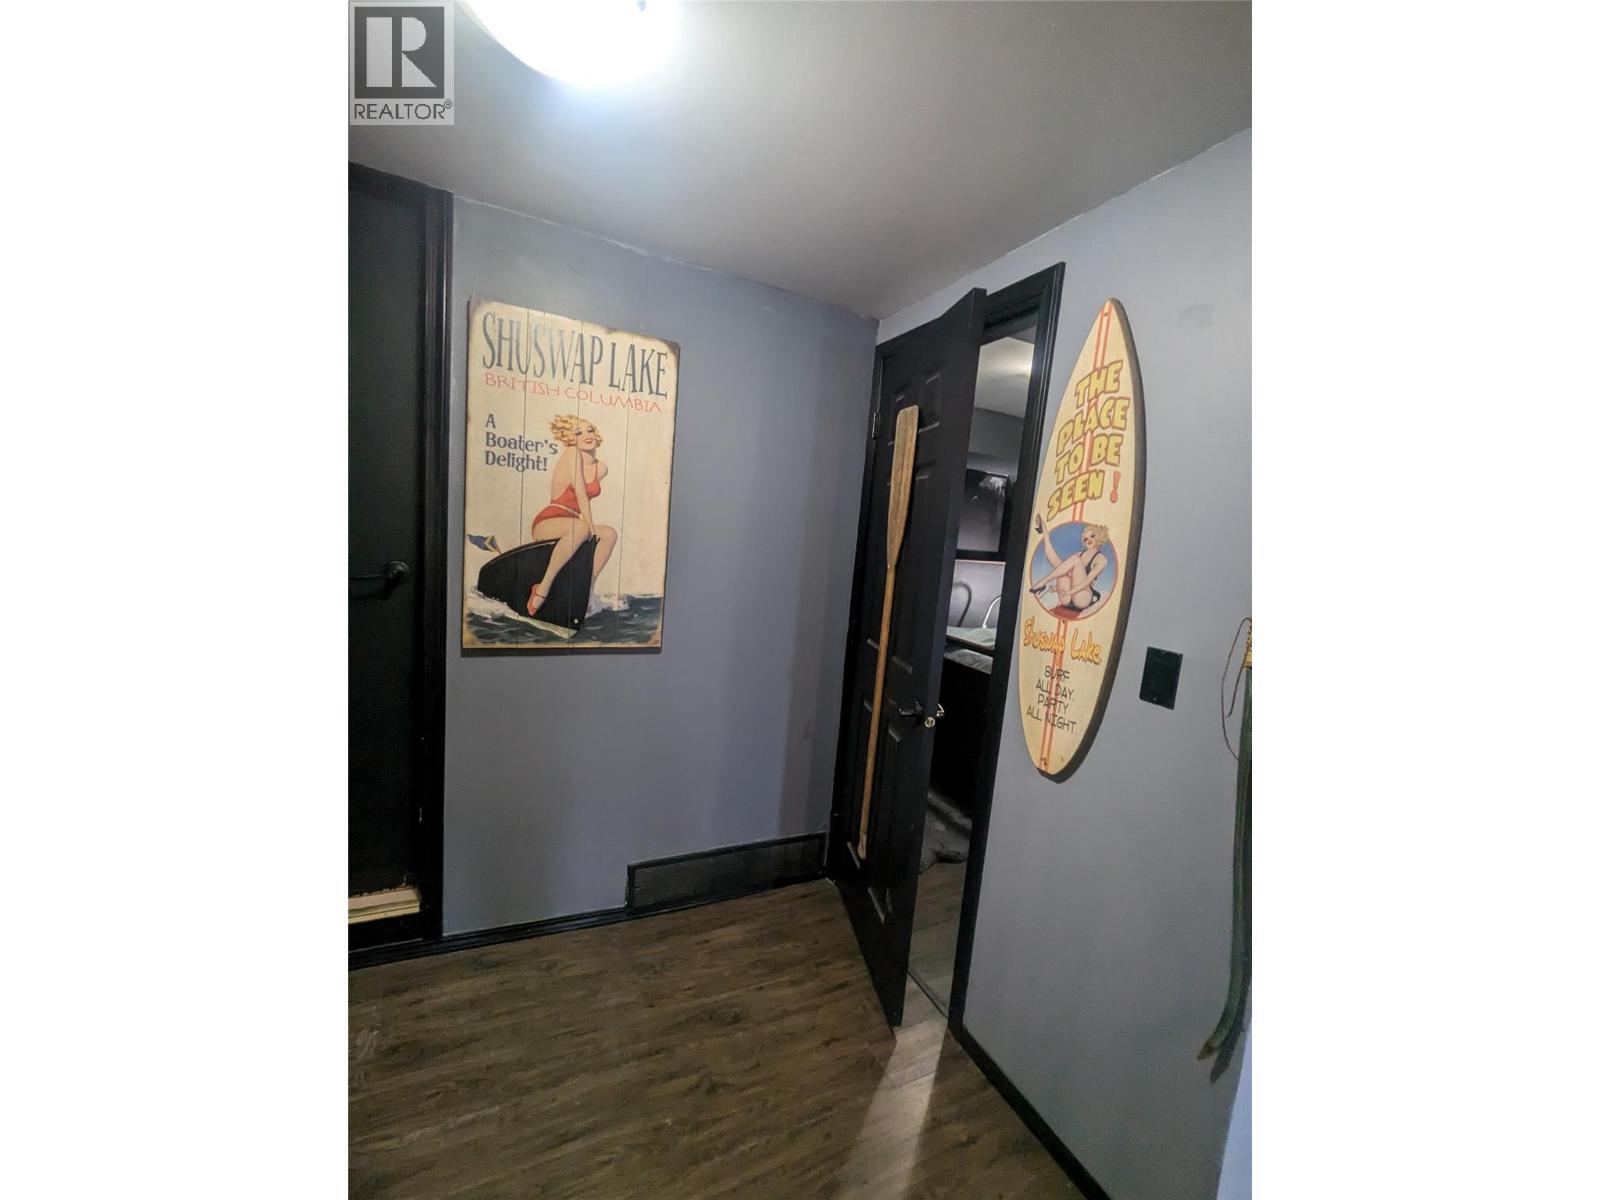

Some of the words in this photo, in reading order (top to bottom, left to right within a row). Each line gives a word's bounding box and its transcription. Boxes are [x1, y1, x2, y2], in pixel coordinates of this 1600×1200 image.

[482, 311, 604, 386] SHUSWAP
[608, 342, 668, 399] LAKE
[485, 372, 560, 396] BRITISH
[564, 387, 662, 413] COLUMBIA
[1074, 360, 1123, 409] THE
[485, 413, 496, 429] A
[1055, 397, 1130, 457] PLACE
[485, 431, 559, 455] Boater's
[484, 450, 548, 473] Delight!
[1055, 443, 1084, 485] TO
[1090, 434, 1124, 467] BE
[1044, 665, 1070, 682] SURF
[1036, 678, 1051, 694] ALL
[1026, 705, 1042, 721] ALL
[1037, 694, 1069, 714] PARTY
